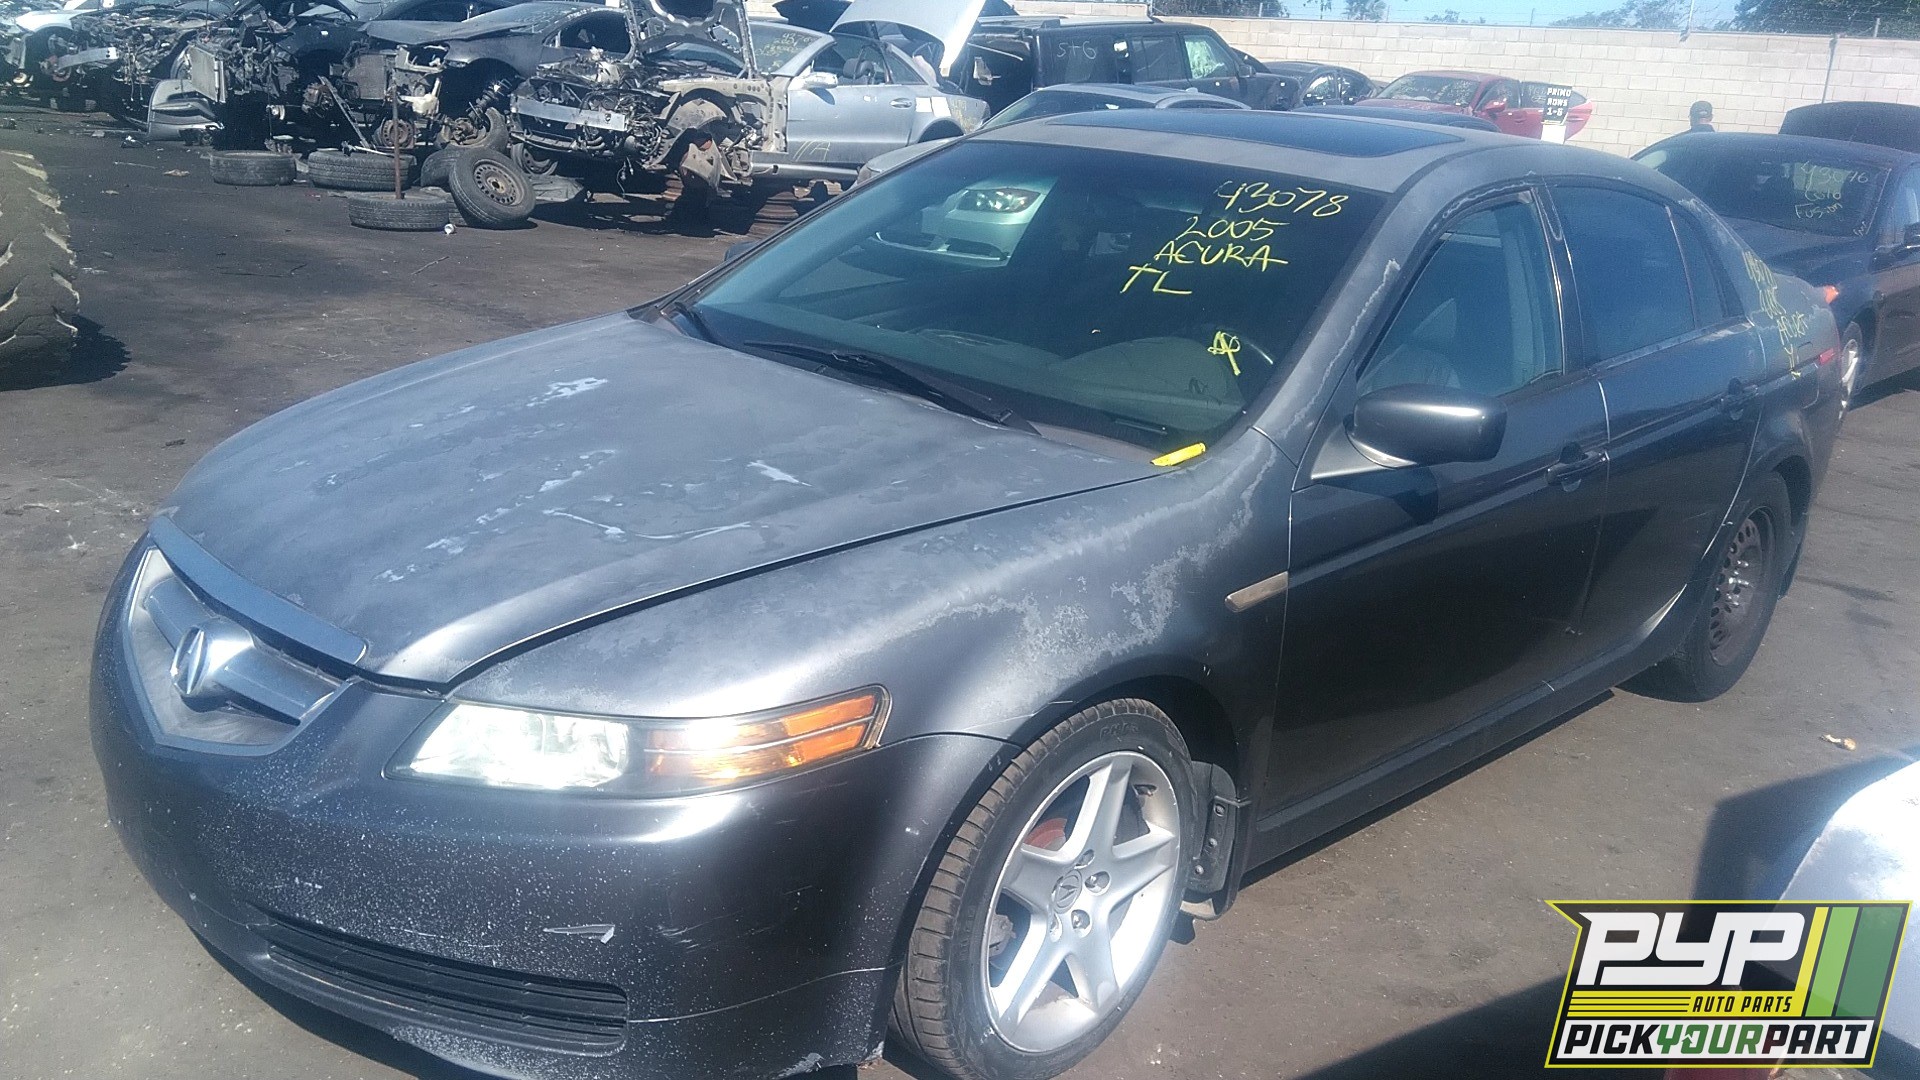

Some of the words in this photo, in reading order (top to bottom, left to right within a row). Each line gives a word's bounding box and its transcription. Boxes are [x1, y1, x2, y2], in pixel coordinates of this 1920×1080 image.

[1546, 87, 1572, 97] PRIMO
[1546, 97, 1569, 107] ROWS
[1215, 180, 1349, 217] 43078
[1175, 216, 1290, 242] 2005
[1154, 240, 1289, 272] ACURA
[1120, 262, 1192, 294] TL
